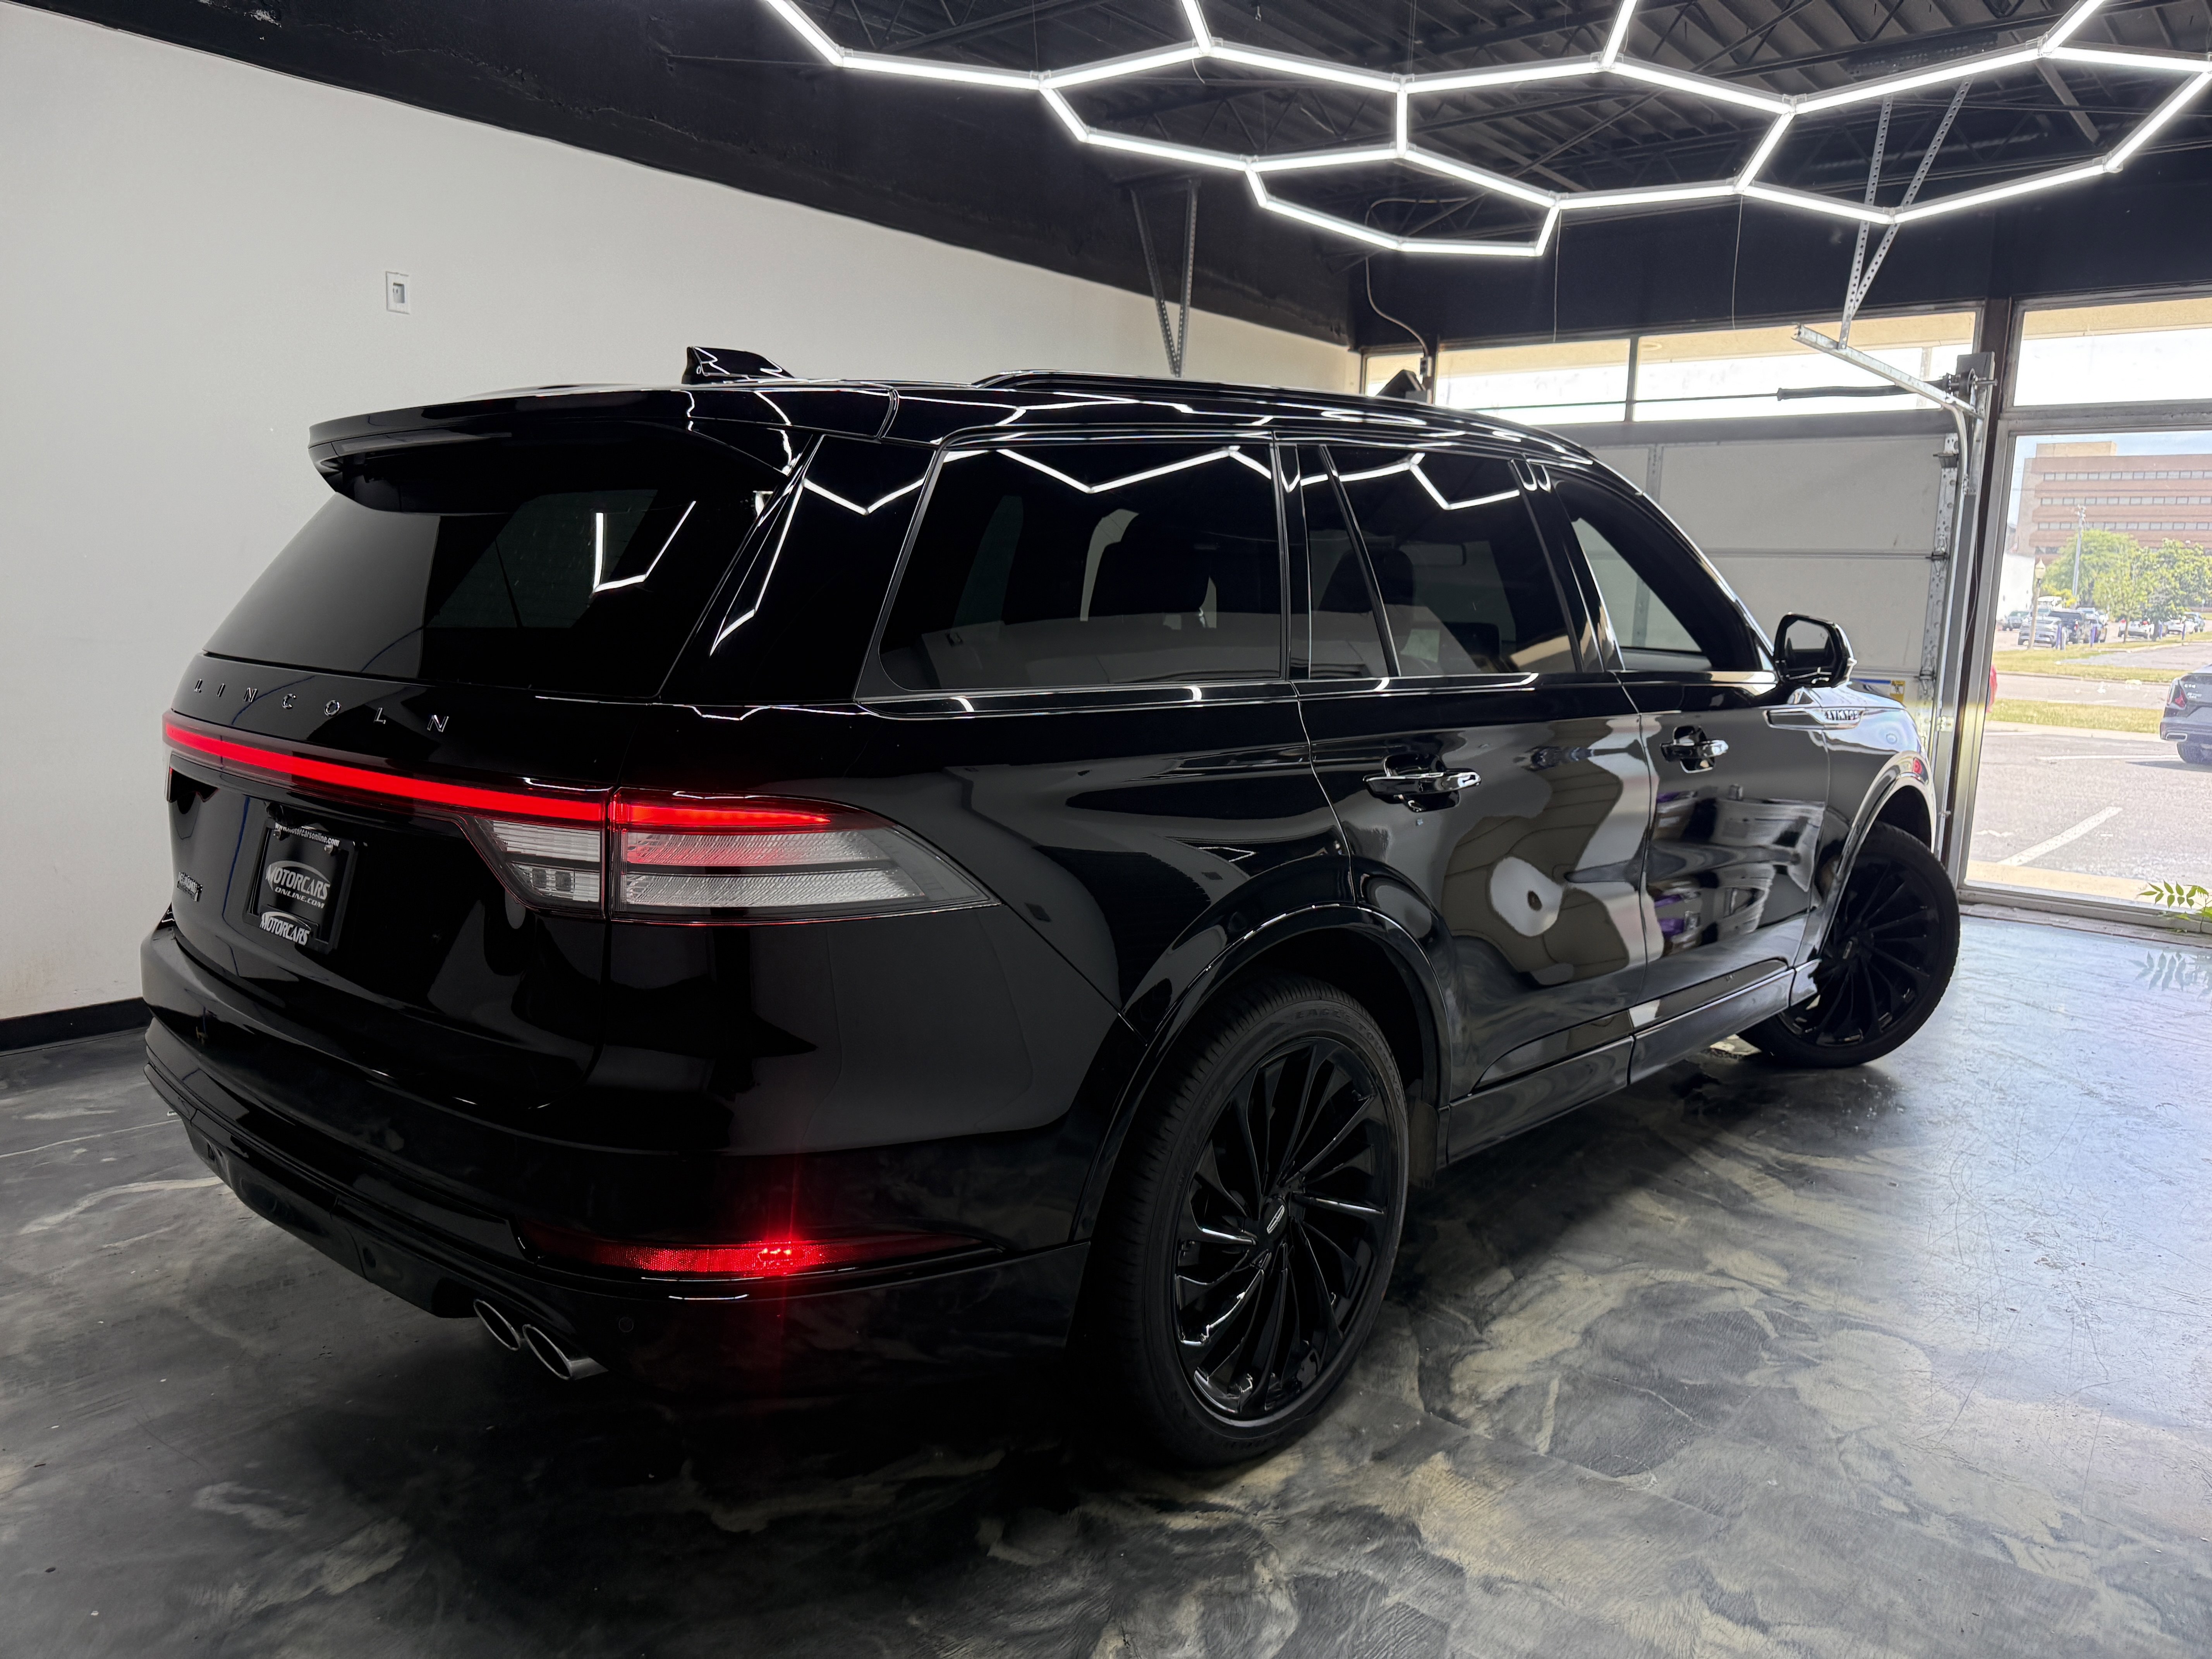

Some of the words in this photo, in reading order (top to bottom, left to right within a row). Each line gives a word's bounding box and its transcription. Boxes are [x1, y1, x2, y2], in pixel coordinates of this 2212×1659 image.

[194, 679, 449, 732] LINCOLN
[265, 864, 330, 900] MOTORCARS
[275, 887, 325, 908] ONLINE.COM
[259, 914, 310, 946] MOTORCARS
[1295, 1008, 1353, 1023] EAGLE
